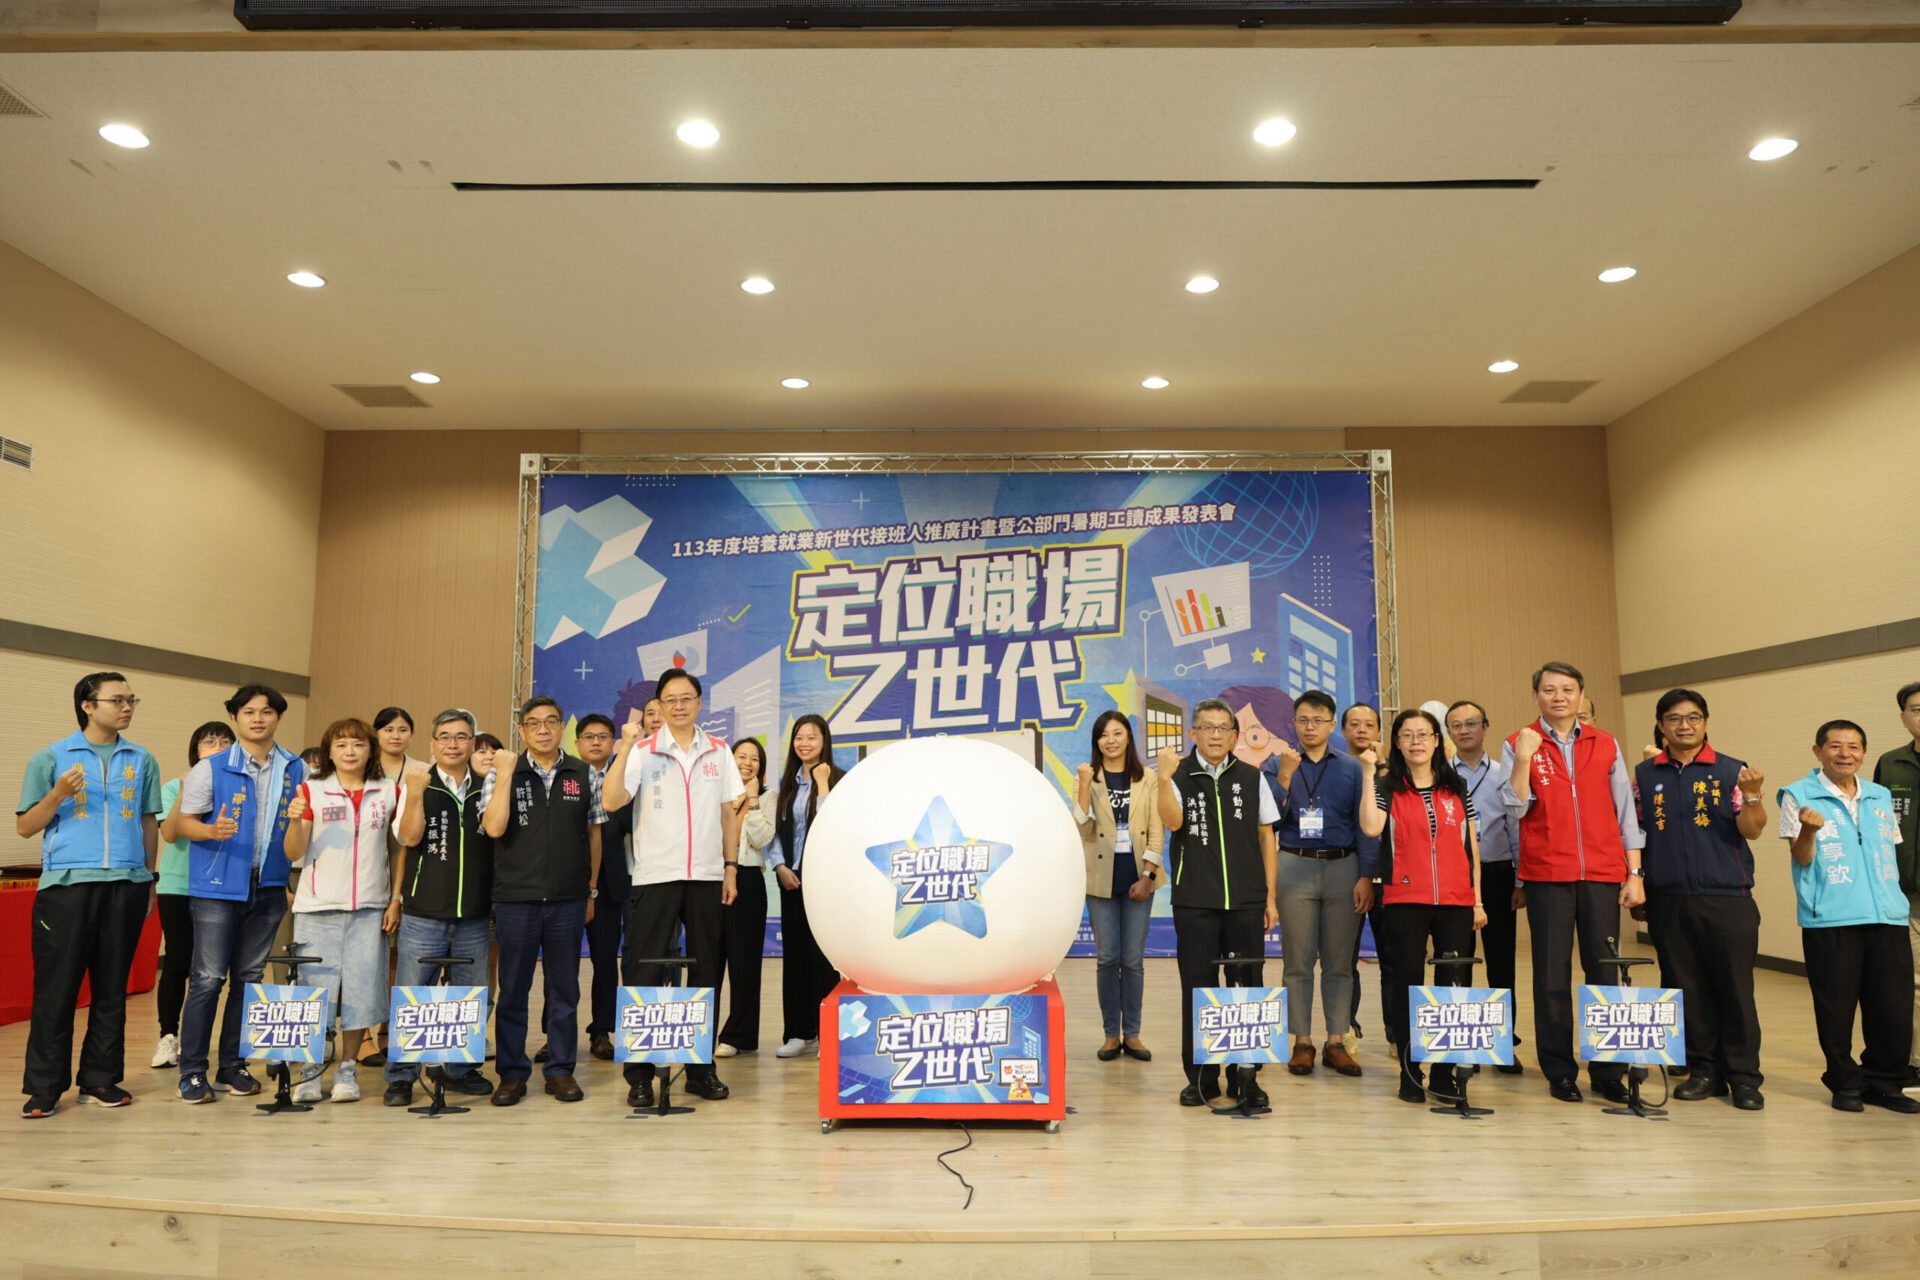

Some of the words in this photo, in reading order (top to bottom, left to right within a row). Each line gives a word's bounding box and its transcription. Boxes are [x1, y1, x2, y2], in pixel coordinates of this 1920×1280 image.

[672, 503, 1237, 557] 113年度培養就業新世代接班人推廣計畫暨公部門暑期工讀成果發表會
[794, 548, 1119, 651] 定位職場
[826, 640, 1078, 735] Z世代
[1231, 782, 1243, 821] 勞動局
[1653, 792, 1667, 832] 陳文吉
[1693, 781, 1711, 828] 陳美梅
[891, 845, 989, 878] 定位職場
[901, 872, 977, 904] Z世代
[248, 1001, 321, 1024] 定位職場
[396, 1000, 479, 1027] 定位職場
[622, 1001, 707, 1028] 定位職場
[1200, 1001, 1280, 1030] 定位職場
[1416, 1002, 1504, 1027] 定位職場
[1585, 1002, 1675, 1027] 定位職場
[253, 1025, 310, 1047] Z世代
[403, 1025, 467, 1050] Z世代
[630, 1026, 694, 1051] Z世代
[878, 1008, 1008, 1051] 定位職場
[1209, 1025, 1270, 1052] Z世代
[1426, 1027, 1494, 1050] Z世代
[1595, 1027, 1666, 1050] Z世代
[891, 1047, 992, 1087] Z世代
